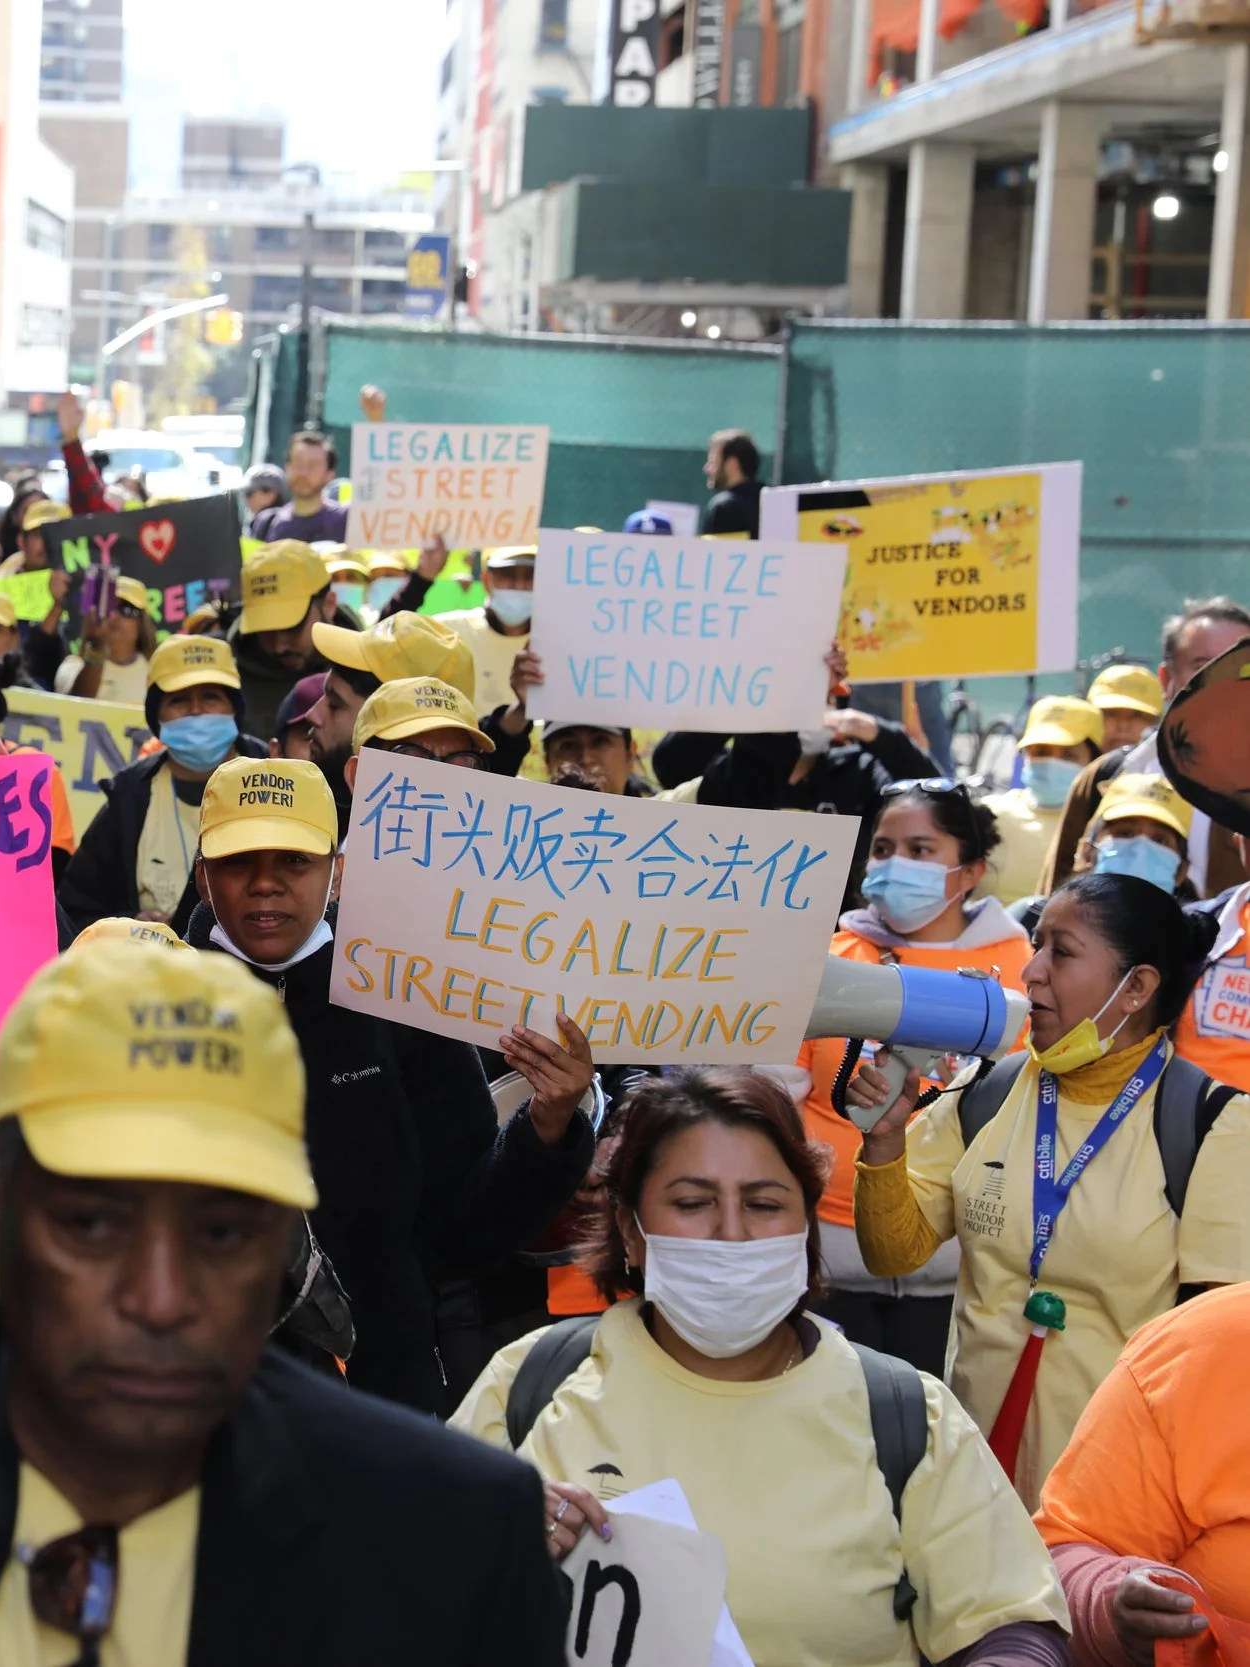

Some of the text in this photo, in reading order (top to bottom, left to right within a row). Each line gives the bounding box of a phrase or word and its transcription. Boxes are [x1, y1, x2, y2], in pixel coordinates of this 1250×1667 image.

[368, 430, 536, 462] LEGALIZE
[386, 467, 521, 500] STREET
[359, 504, 537, 546] VENDING!
[866, 541, 962, 565] JUSTICE
[565, 545, 784, 597] LEGALIZE
[936, 567, 981, 586] FOR
[592, 598, 749, 639] STREET
[913, 593, 1026, 616] VENDORS
[568, 655, 774, 708] VENDING
[241, 773, 295, 792] VENDOR
[238, 791, 294, 809] POWER!
[359, 771, 828, 910] 街头贩卖合法化
[444, 887, 749, 983] LEGALIZE
[344, 937, 784, 1053] STREET VENDING
[1222, 973, 1250, 993] NE
[128, 996, 243, 1035] VENDOR
[342, 1066, 381, 1083] Columbia
[964, 1207, 1005, 1227] VENDOR
[965, 1197, 1007, 1216] STREET
[964, 1219, 1002, 1238] PROJECT
